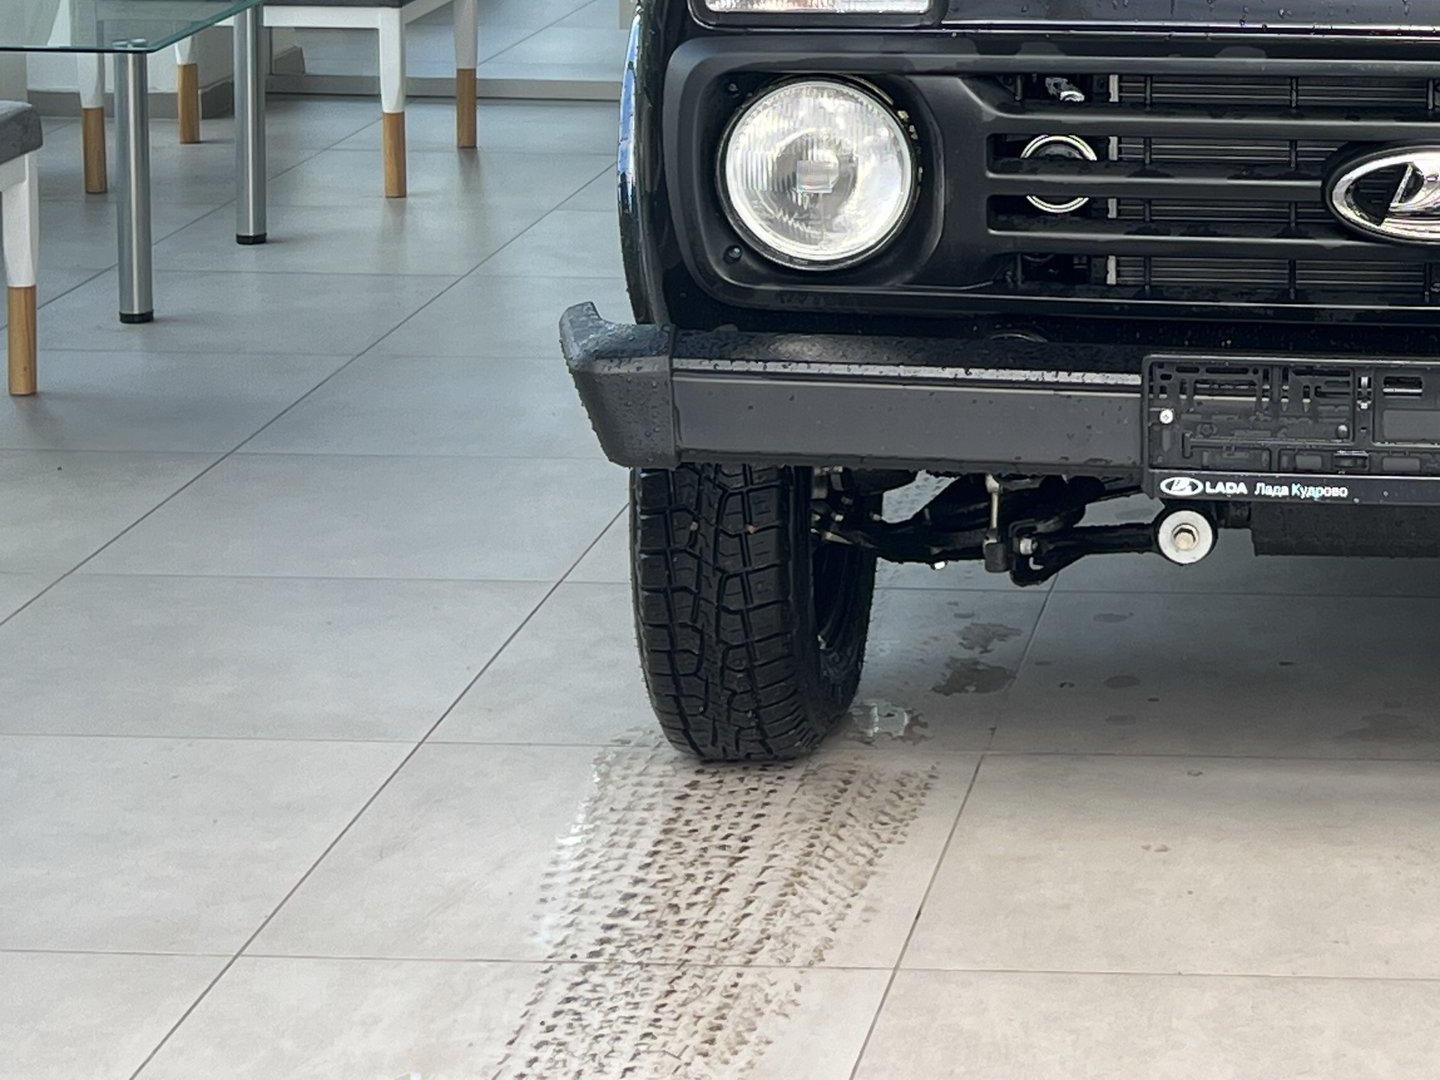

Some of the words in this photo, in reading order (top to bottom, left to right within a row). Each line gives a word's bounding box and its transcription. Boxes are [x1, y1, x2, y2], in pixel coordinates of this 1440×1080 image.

[1205, 481, 1248, 495] LADA
[1254, 482, 1289, 497] Лада
[1291, 483, 1349, 501] Кудрово
